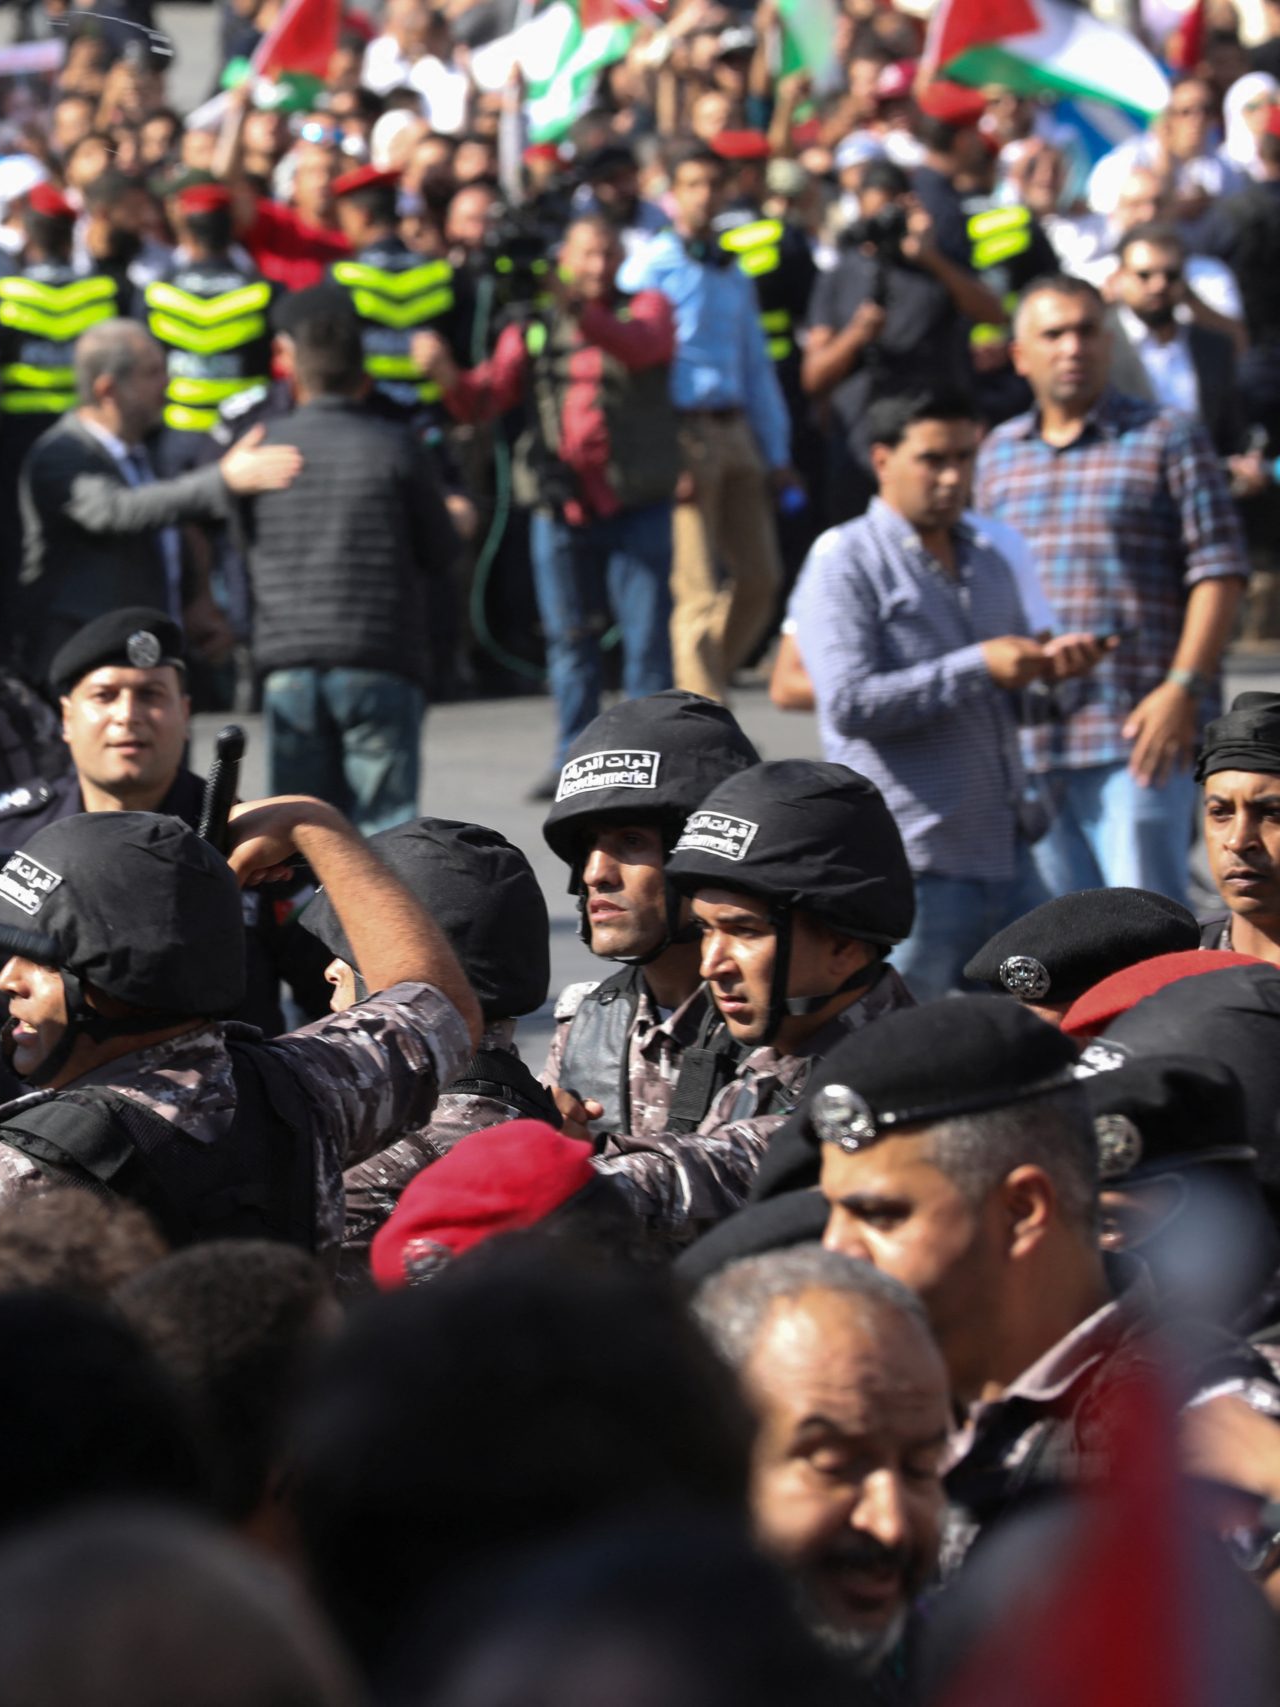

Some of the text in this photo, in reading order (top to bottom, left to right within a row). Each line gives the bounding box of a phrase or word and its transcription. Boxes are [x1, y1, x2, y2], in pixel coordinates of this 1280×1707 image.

[606, 754, 652, 769] قوات
[562, 770, 649, 795] Gendarmerie
[707, 819, 749, 838] قوات
[17, 865, 54, 890] قوات
